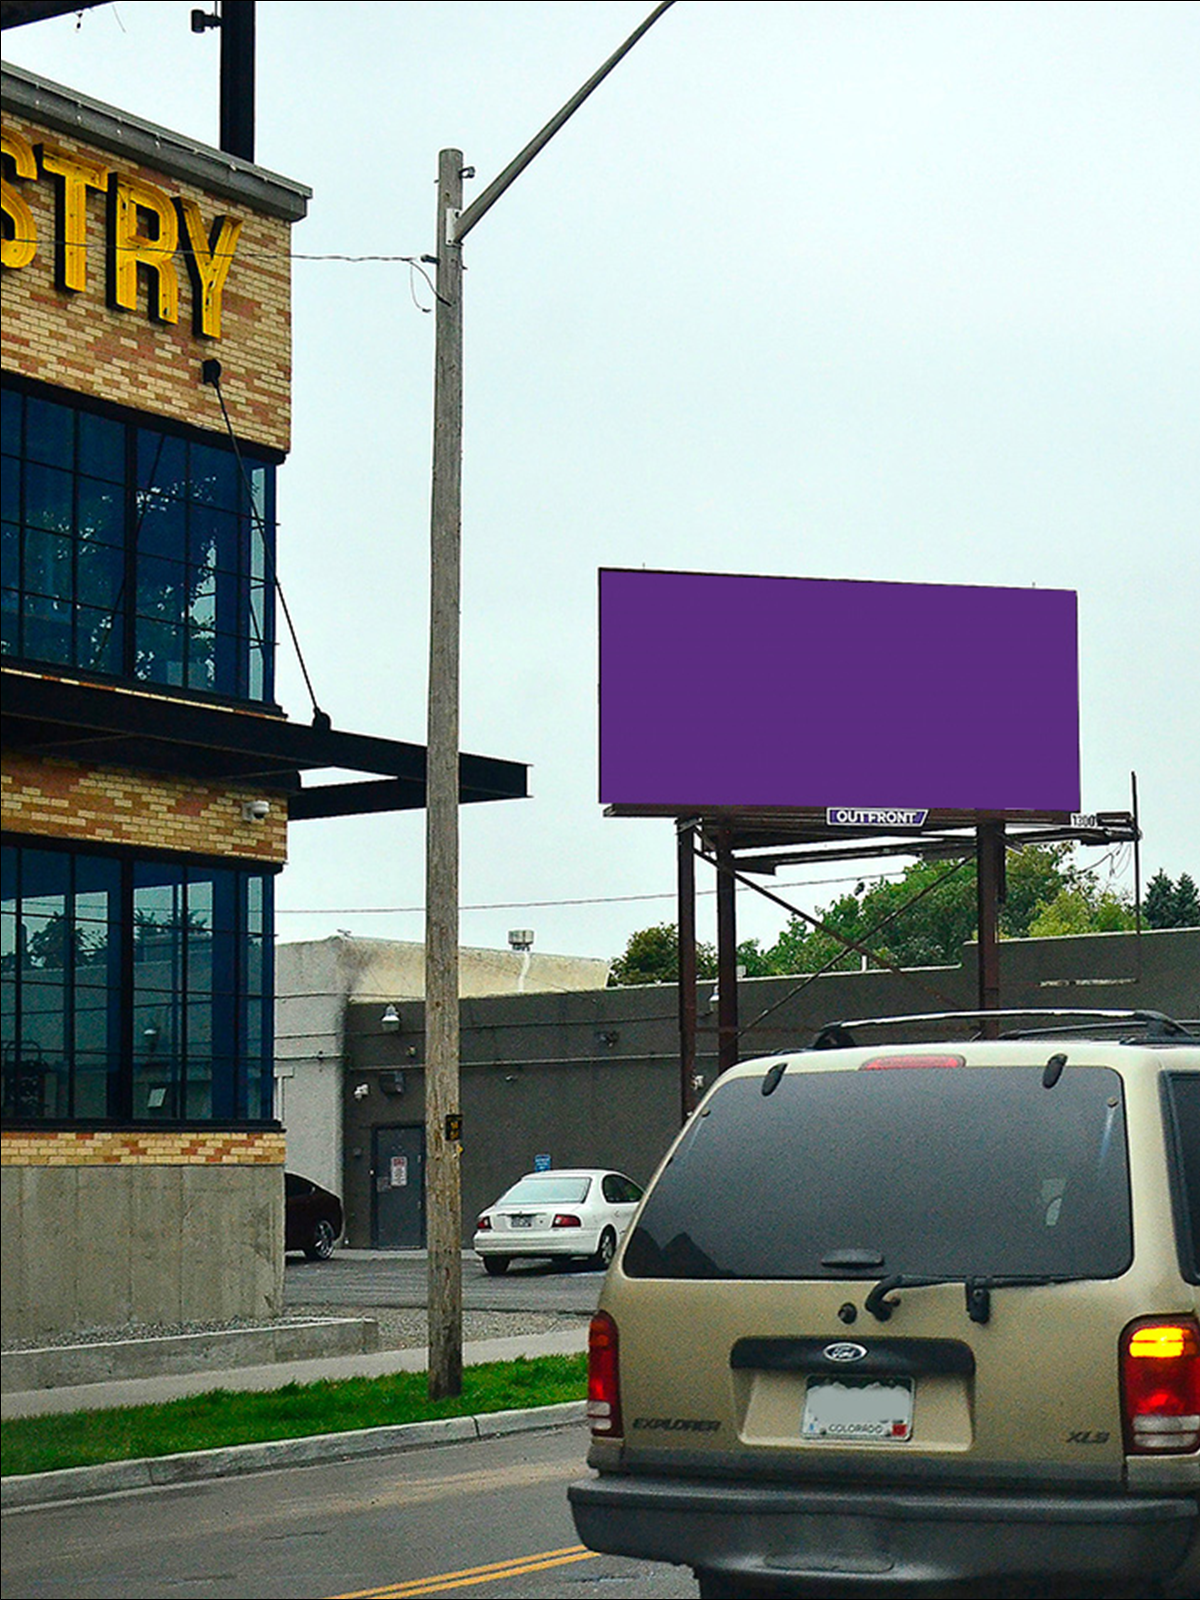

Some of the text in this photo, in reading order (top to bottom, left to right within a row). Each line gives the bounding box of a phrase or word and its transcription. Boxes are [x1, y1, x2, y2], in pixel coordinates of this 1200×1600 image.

[836, 810, 917, 824] OUTFRONT
[633, 1417, 722, 1432] EXPLORER
[828, 1423, 884, 1434] COLORADO
